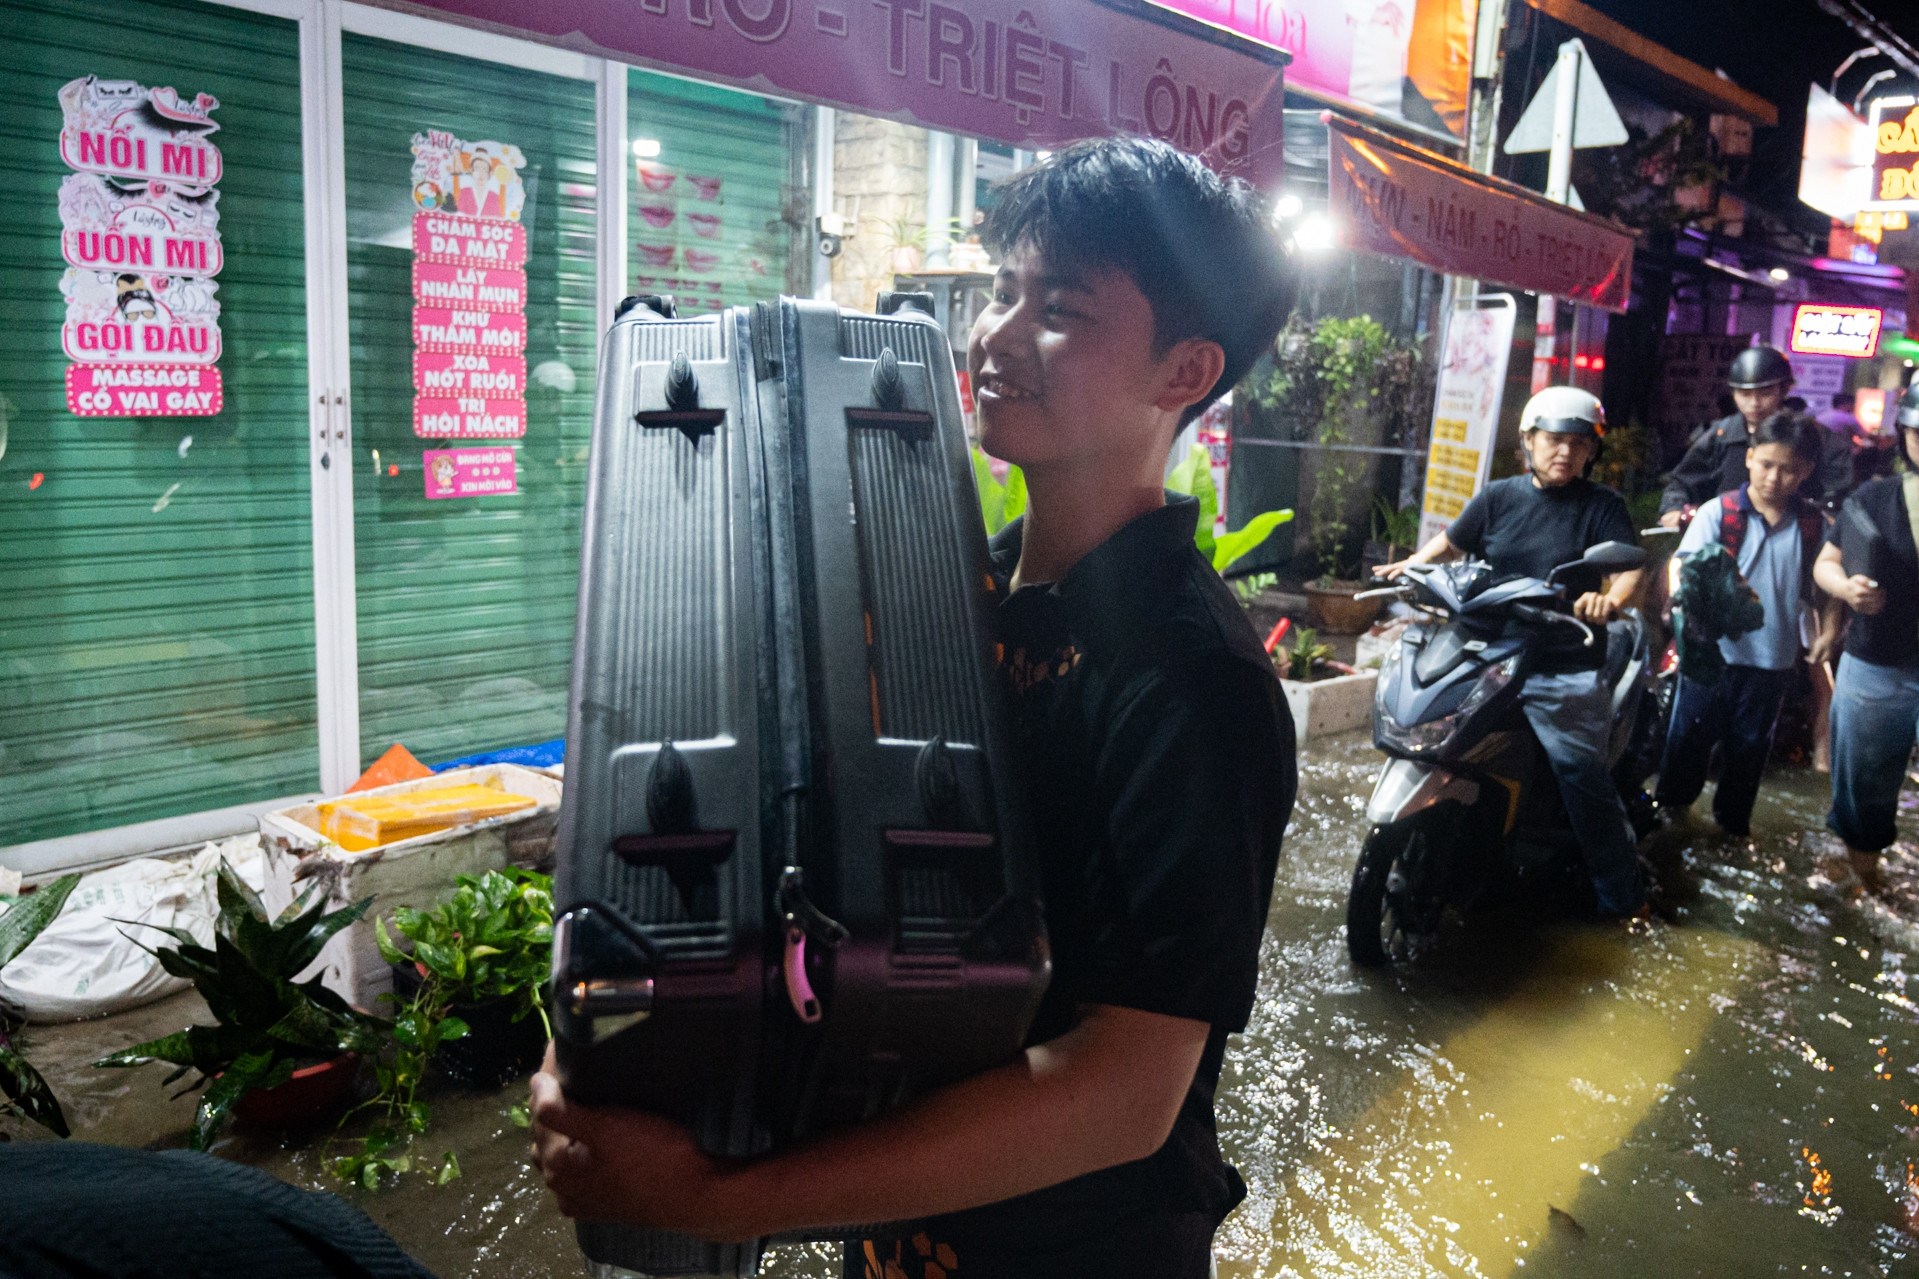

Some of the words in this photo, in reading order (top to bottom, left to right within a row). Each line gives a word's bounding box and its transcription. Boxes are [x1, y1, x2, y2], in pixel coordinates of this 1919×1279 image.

[871, 0, 1089, 127] TRIỆT
[1107, 57, 1254, 167] LÔNG
[79, 125, 147, 171] NỐI
[161, 142, 207, 179] MI
[77, 222, 153, 267] UỐN
[165, 238, 208, 270] MI
[430, 235, 461, 256] DA
[478, 285, 520, 307] MỤN
[77, 317, 134, 359] GỘI
[143, 314, 209, 354] ĐẦU
[481, 326, 520, 348] MÔI
[91, 368, 201, 388] MASSAGE
[118, 391, 160, 410] VAI
[166, 387, 214, 411] GÁY
[458, 397, 486, 417] TRỊ
[422, 410, 461, 433] HÔI
[465, 411, 520, 433] NÁCH
